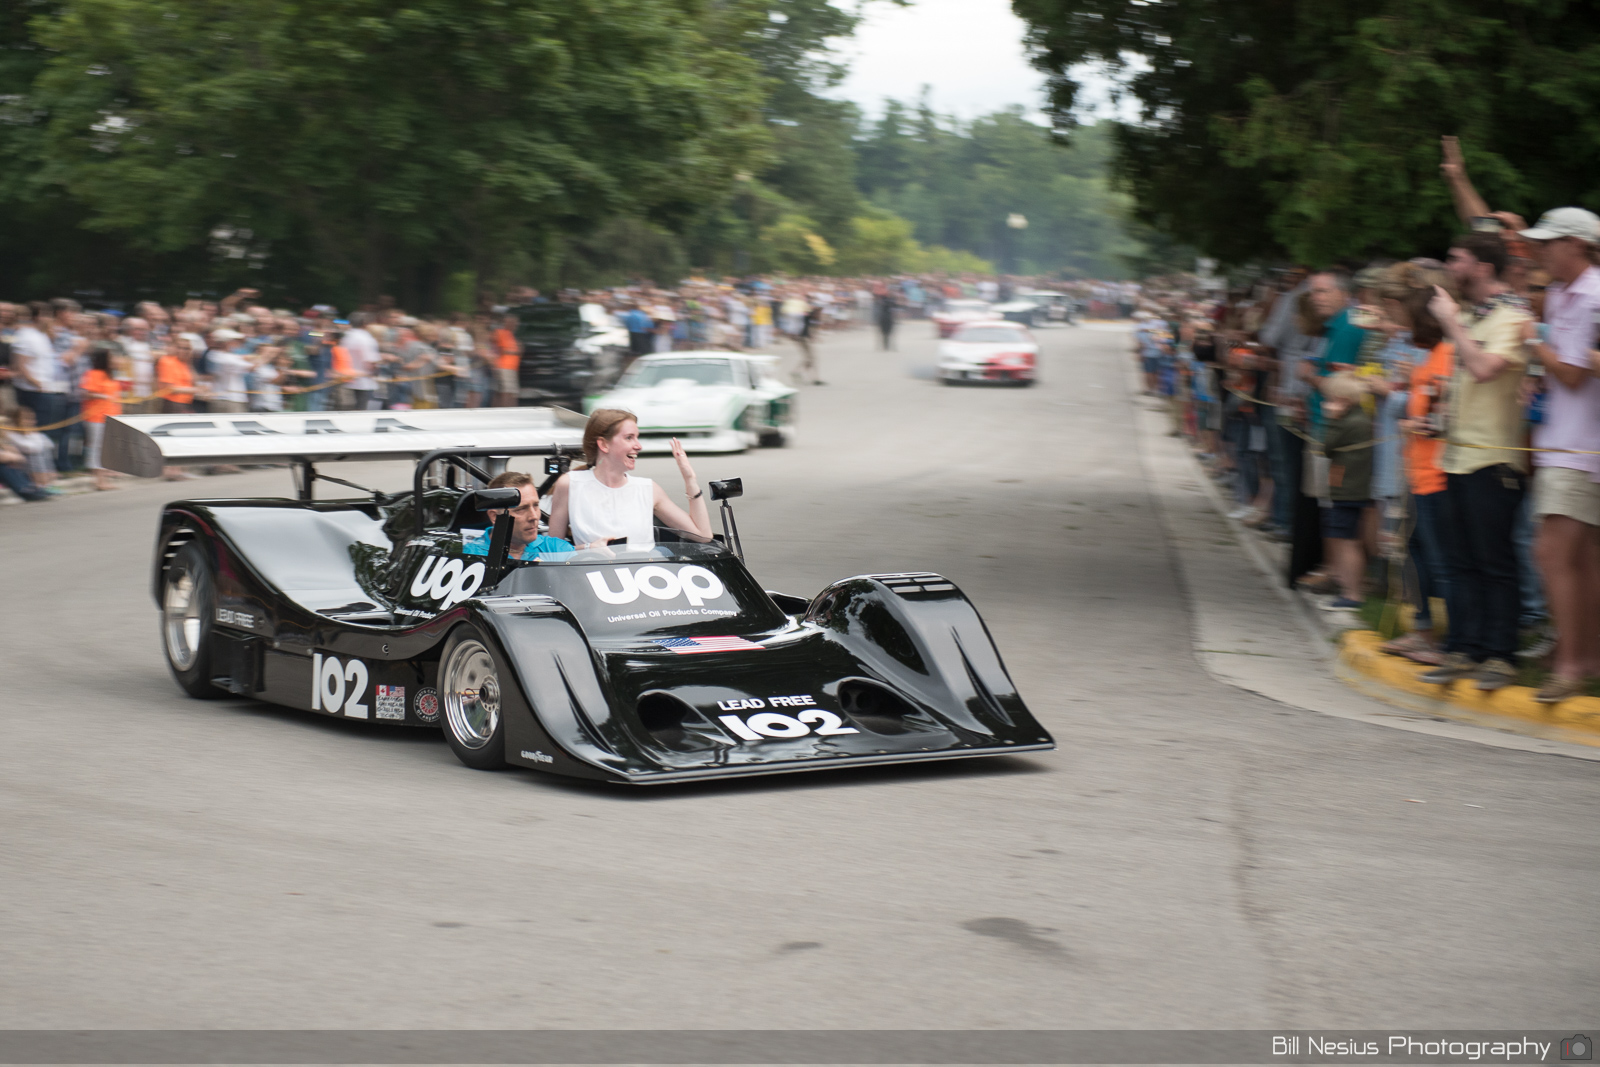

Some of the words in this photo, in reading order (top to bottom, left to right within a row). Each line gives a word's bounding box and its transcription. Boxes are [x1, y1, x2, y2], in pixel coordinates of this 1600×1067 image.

[607, 612, 647, 623] Universal
[648, 610, 661, 618] Oil
[662, 609, 699, 617] Products
[700, 608, 737, 617] Company
[312, 653, 368, 719] 102
[717, 698, 765, 711] LEAD
[768, 695, 817, 708] FREE
[718, 709, 860, 741] 102
